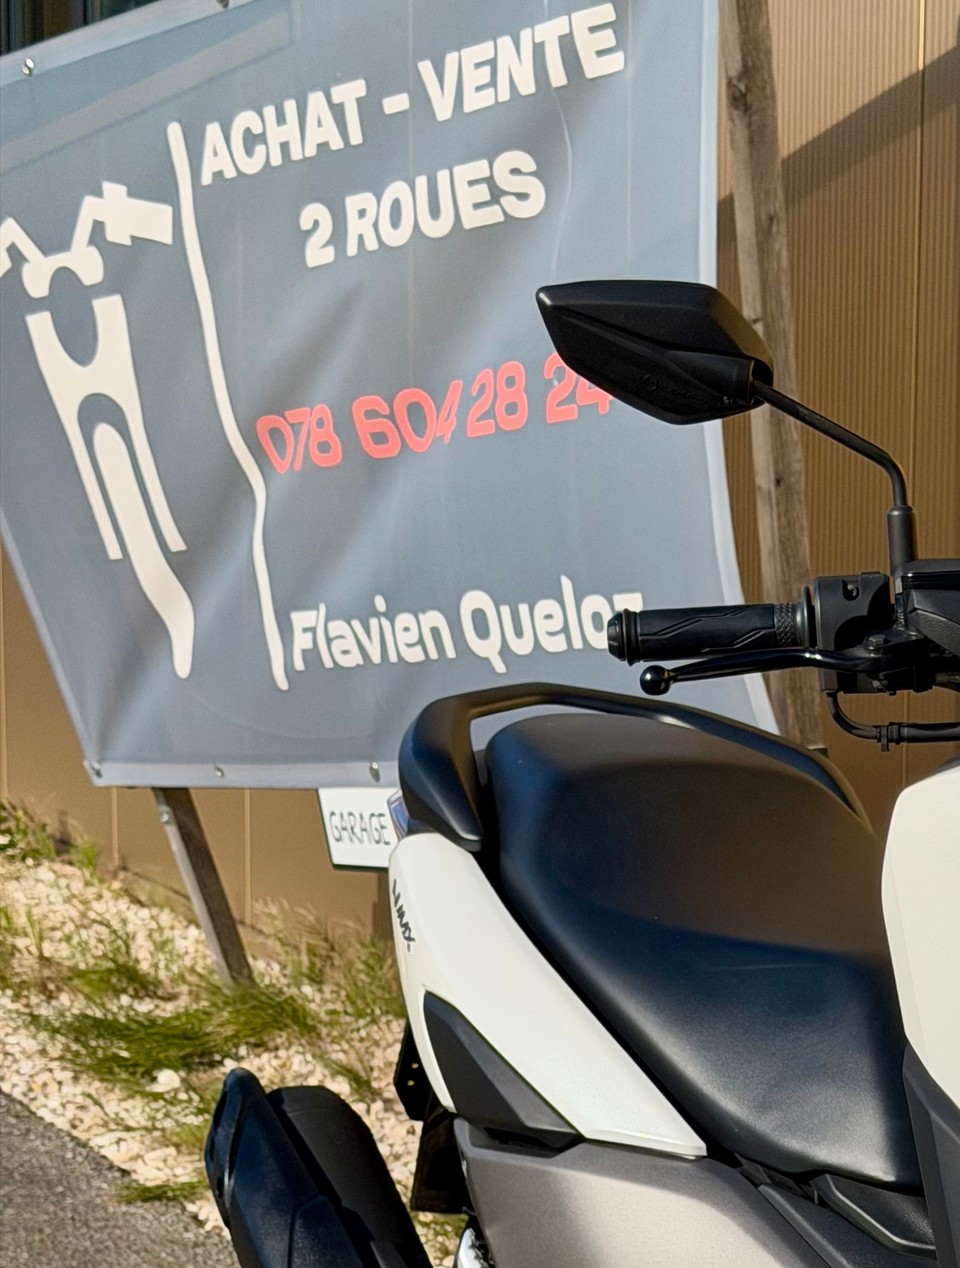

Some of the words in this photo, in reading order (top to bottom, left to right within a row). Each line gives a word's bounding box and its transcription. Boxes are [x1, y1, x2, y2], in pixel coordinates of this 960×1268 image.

[201, 79, 367, 186] ACHAT
[417, 3, 625, 122] VENTE
[299, 202, 335, 268] 2
[345, 150, 546, 257] ROUES
[256, 403, 342, 473] 078
[467, 361, 528, 438] 28
[290, 594, 456, 671] Flavien
[329, 811, 391, 846] GARAGE
